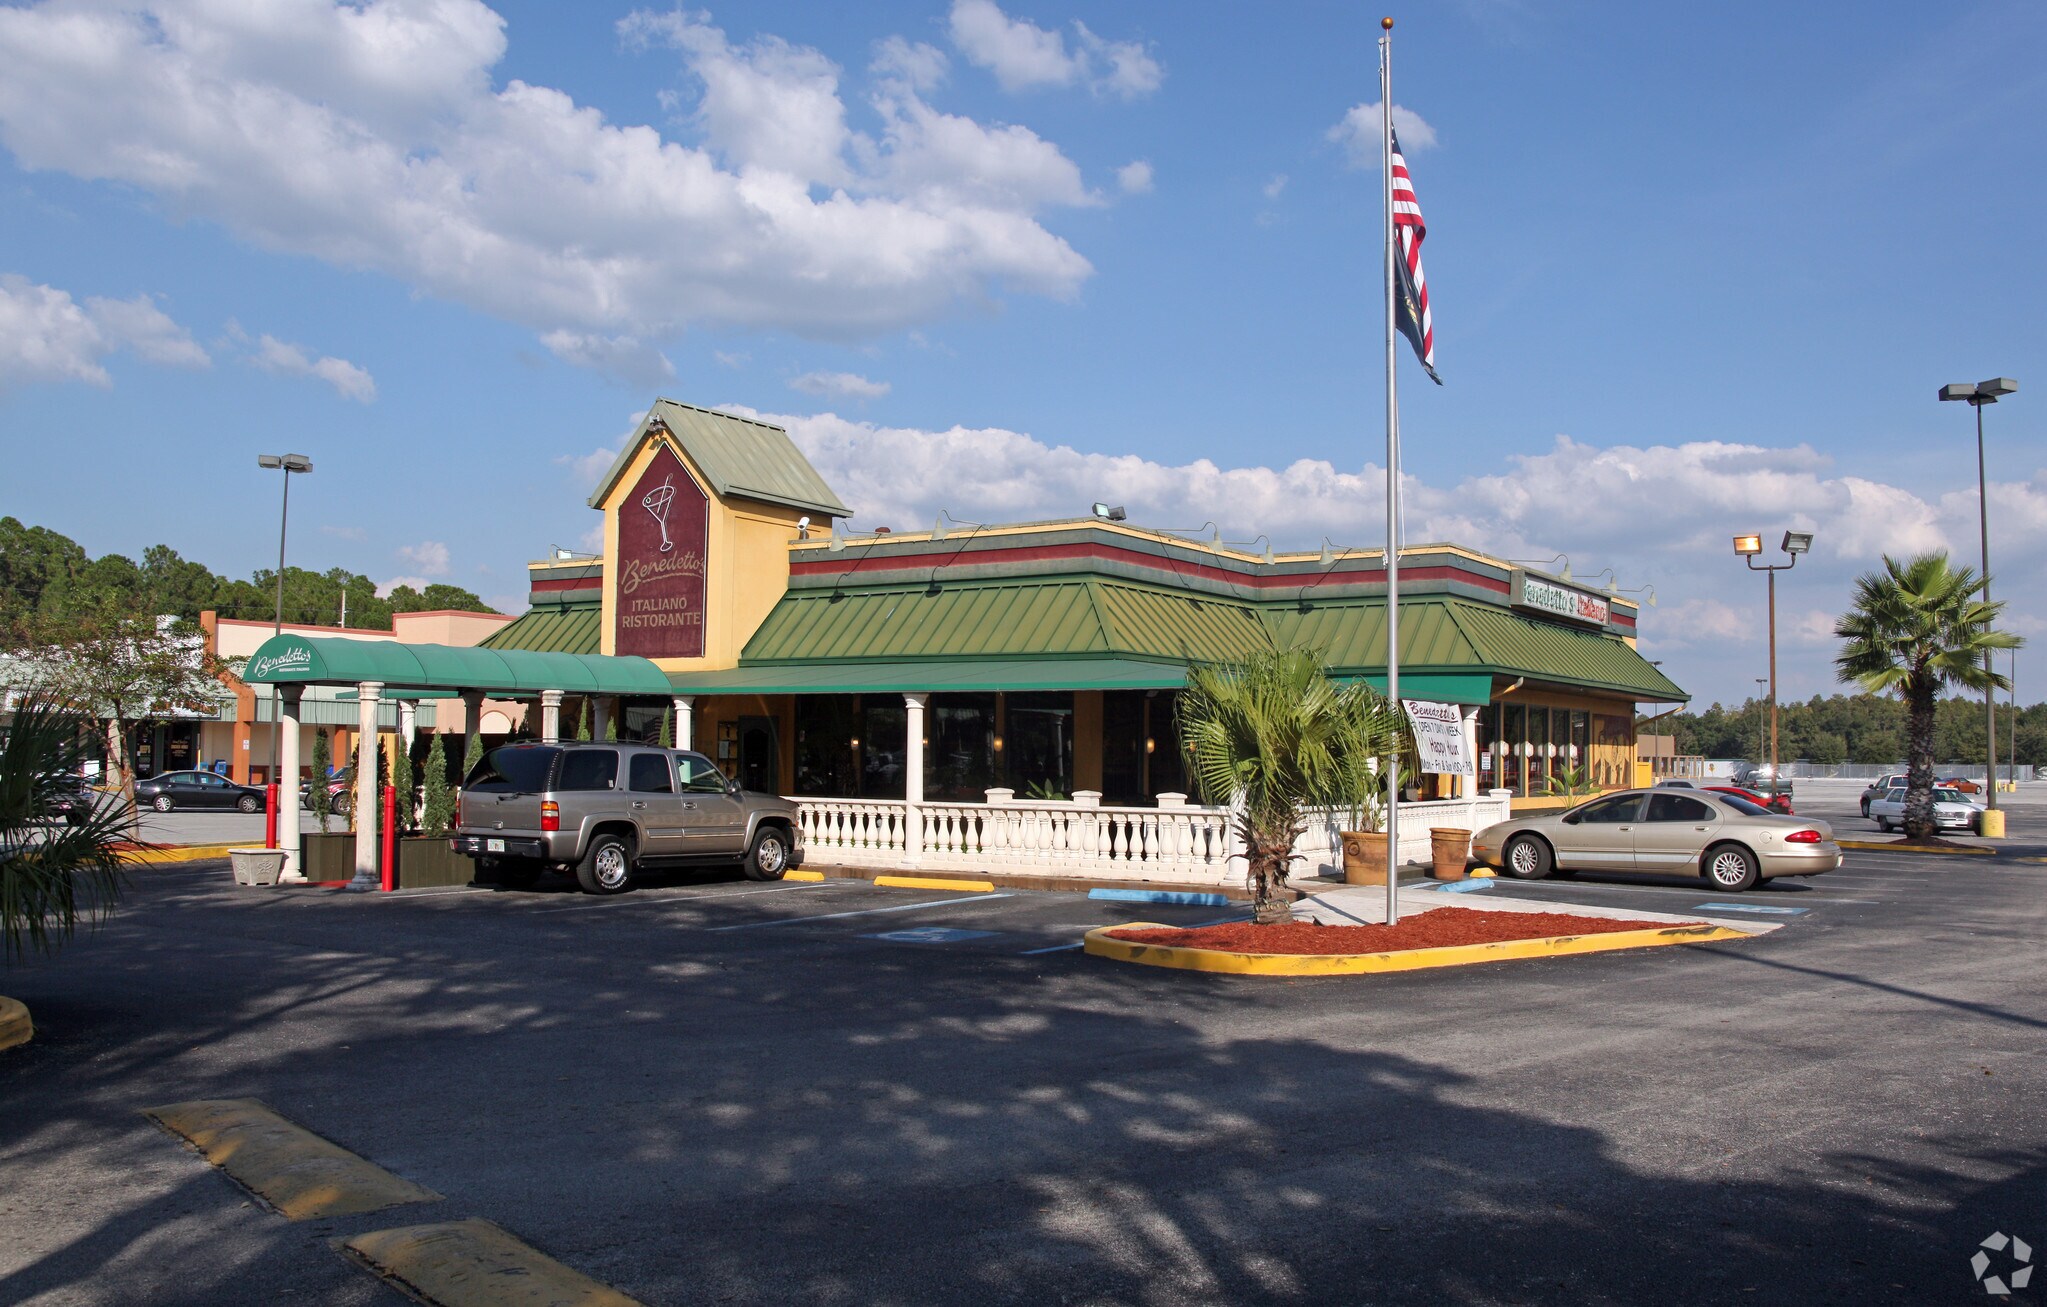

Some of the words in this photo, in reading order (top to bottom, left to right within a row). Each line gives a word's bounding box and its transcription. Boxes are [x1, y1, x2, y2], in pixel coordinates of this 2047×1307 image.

[621, 550, 704, 594] Benedetto's
[632, 597, 688, 612] ITALIANO
[622, 611, 702, 628] RISTORANTE
[254, 647, 311, 677] Benedetto's
[1428, 737, 1447, 757] Happy
